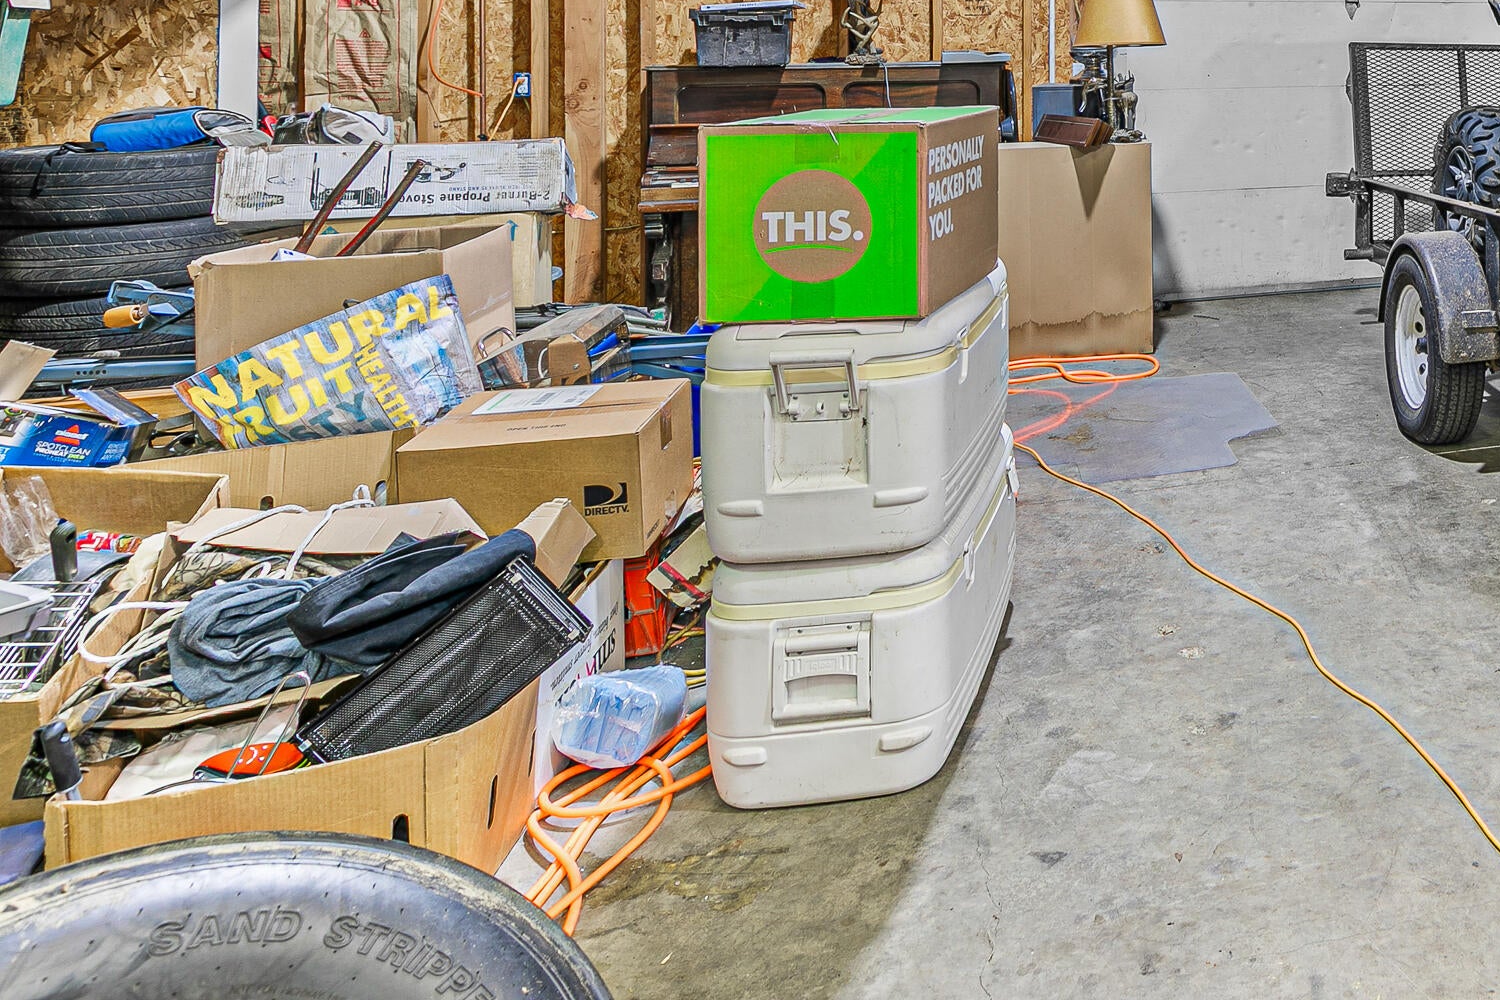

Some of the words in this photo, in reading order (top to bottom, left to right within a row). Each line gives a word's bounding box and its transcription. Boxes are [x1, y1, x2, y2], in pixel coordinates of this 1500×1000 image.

[928, 134, 985, 176] PERSONALLY
[439, 191, 491, 204] Propane
[928, 174, 965, 209] PACKED
[965, 164, 983, 194] FOR
[761, 209, 864, 243] THIS.
[928, 207, 954, 241] YOU.
[188, 285, 450, 420] NATURAL
[35, 440, 91, 457] SPOTCLEAN
[149, 907, 303, 958] SAND
